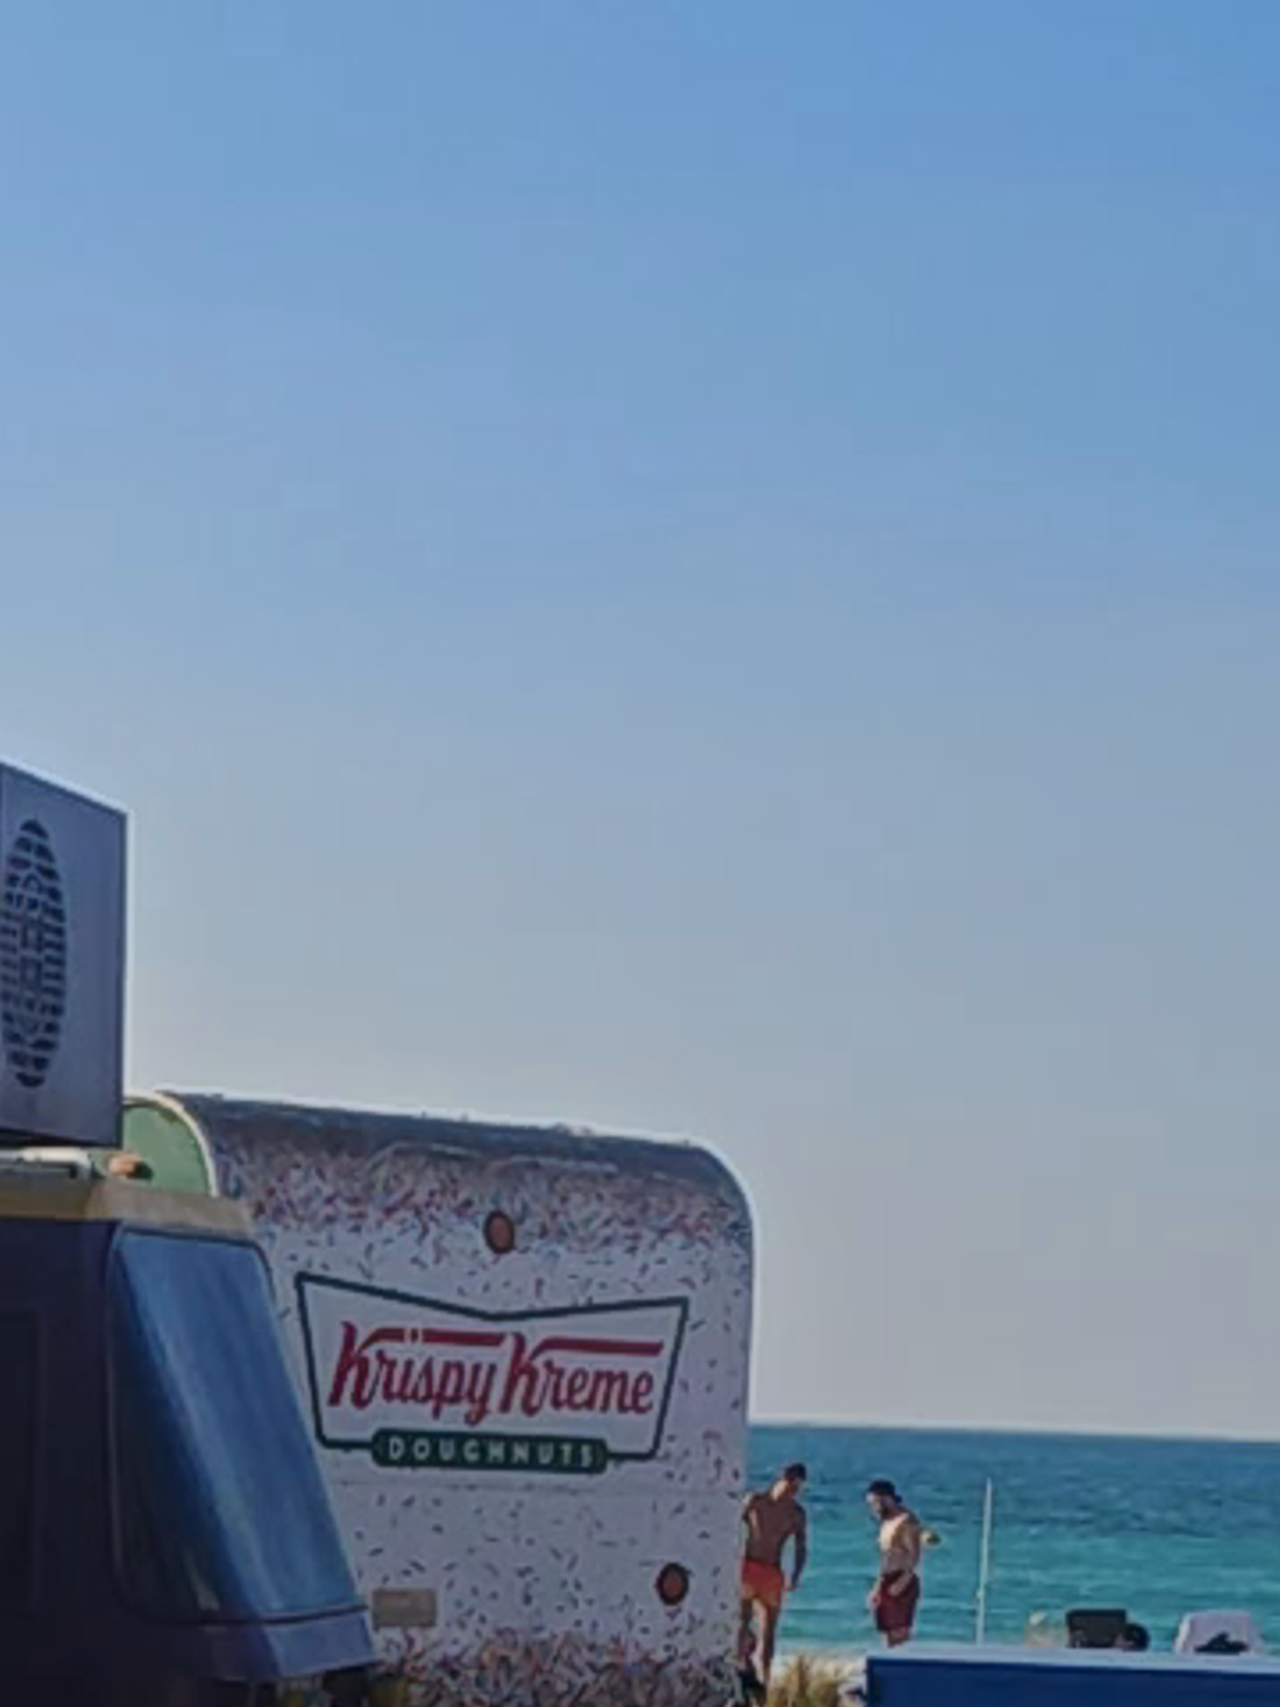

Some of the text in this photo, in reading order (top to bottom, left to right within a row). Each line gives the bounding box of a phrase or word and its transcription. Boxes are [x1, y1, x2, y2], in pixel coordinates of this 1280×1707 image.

[328, 1321, 664, 1427] Krispy Kreme
[388, 1436, 594, 1467] DOUGHNUTS
